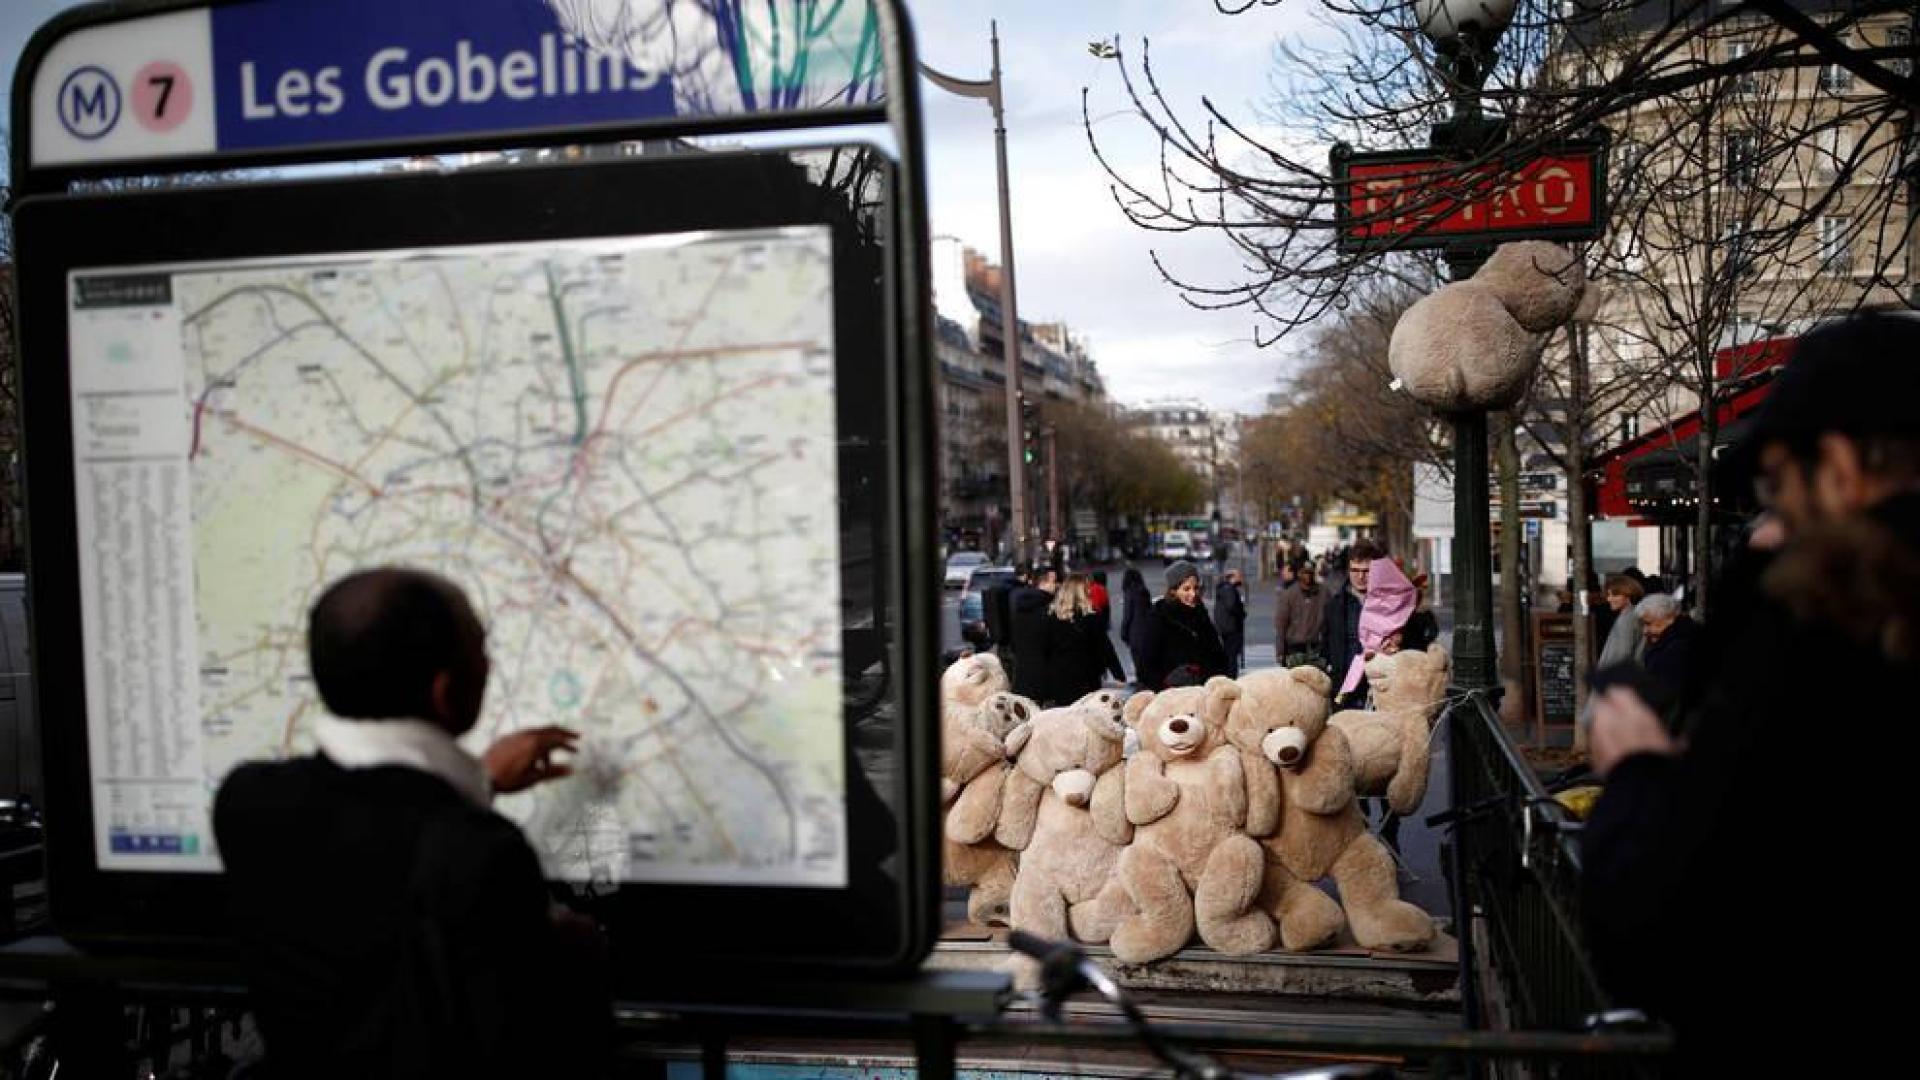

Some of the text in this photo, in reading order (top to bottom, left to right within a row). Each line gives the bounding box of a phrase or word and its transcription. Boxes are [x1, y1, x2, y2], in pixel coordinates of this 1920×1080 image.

[70, 82, 106, 123] M
[149, 75, 174, 118] 7
[240, 62, 344, 119] Les
[1366, 166, 1574, 222] MTRO
